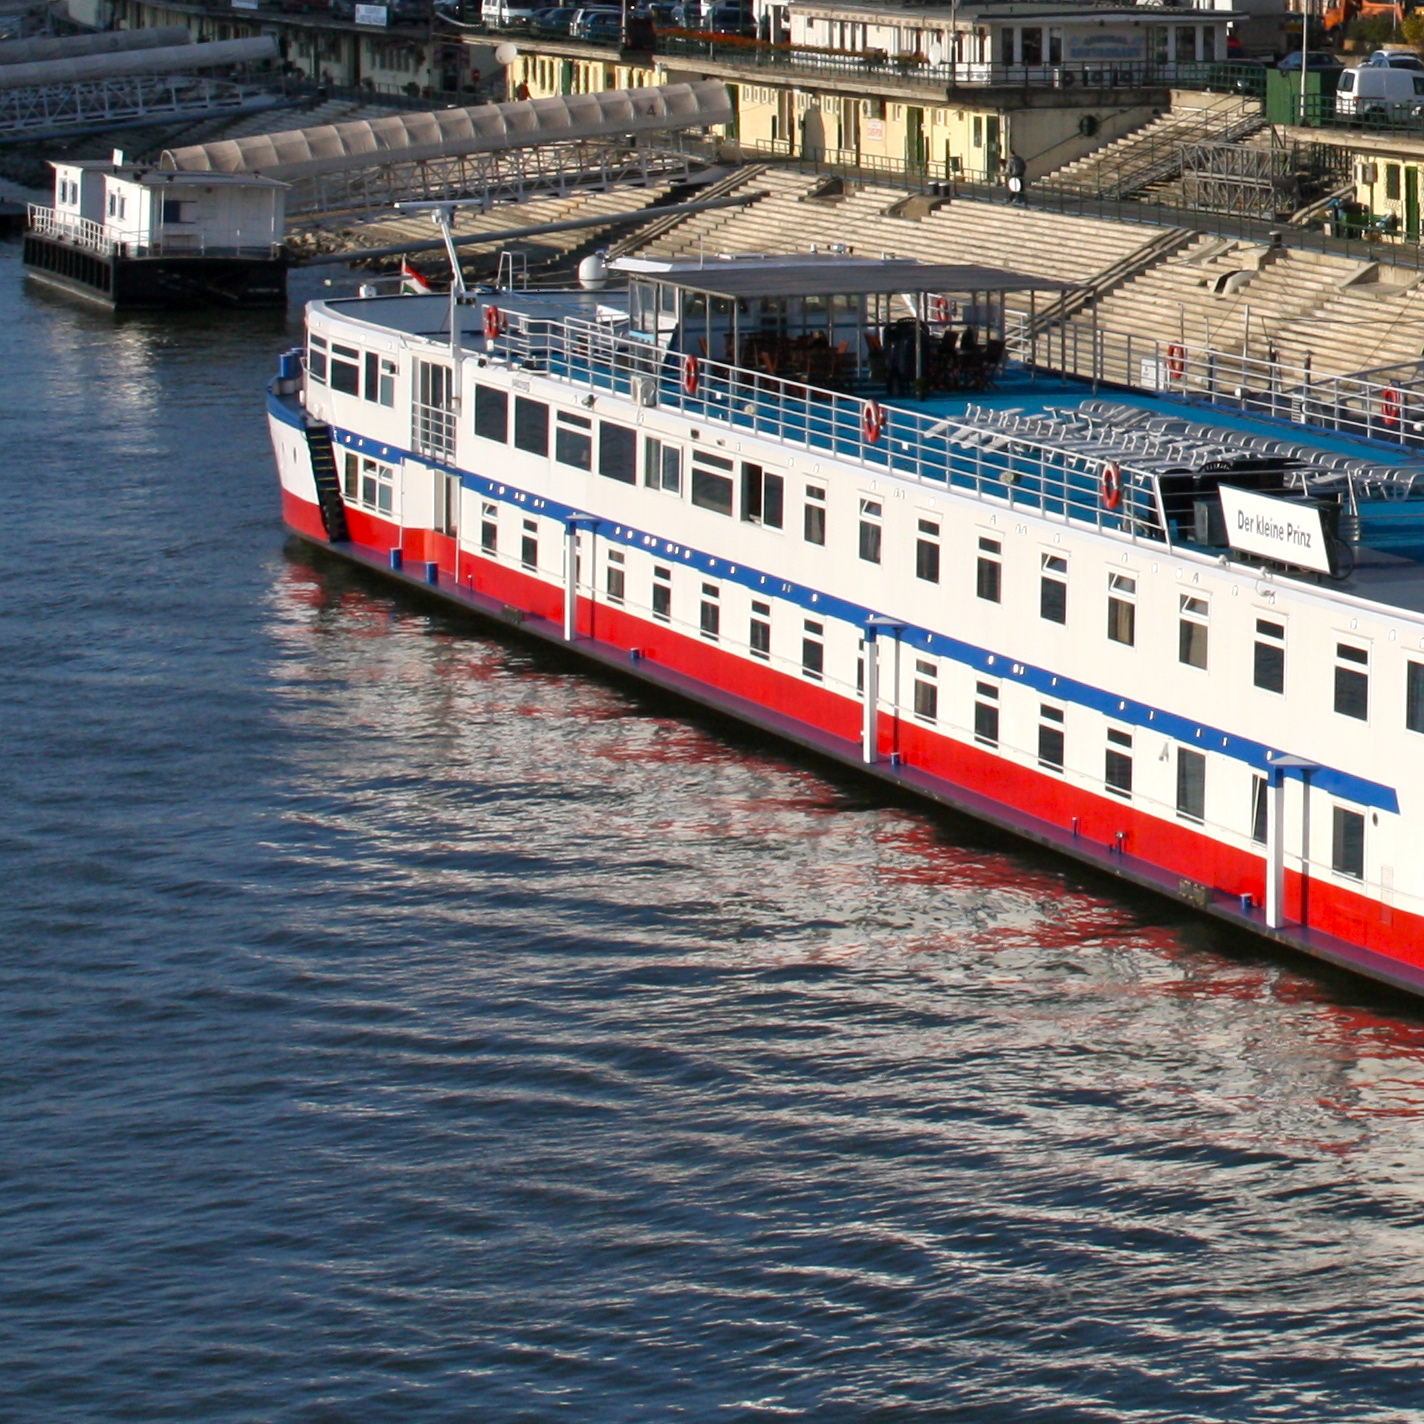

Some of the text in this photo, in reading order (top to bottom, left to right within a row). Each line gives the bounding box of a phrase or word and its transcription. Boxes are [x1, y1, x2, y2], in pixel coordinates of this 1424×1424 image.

[1237, 509, 1312, 549] Der kleine Prinz
